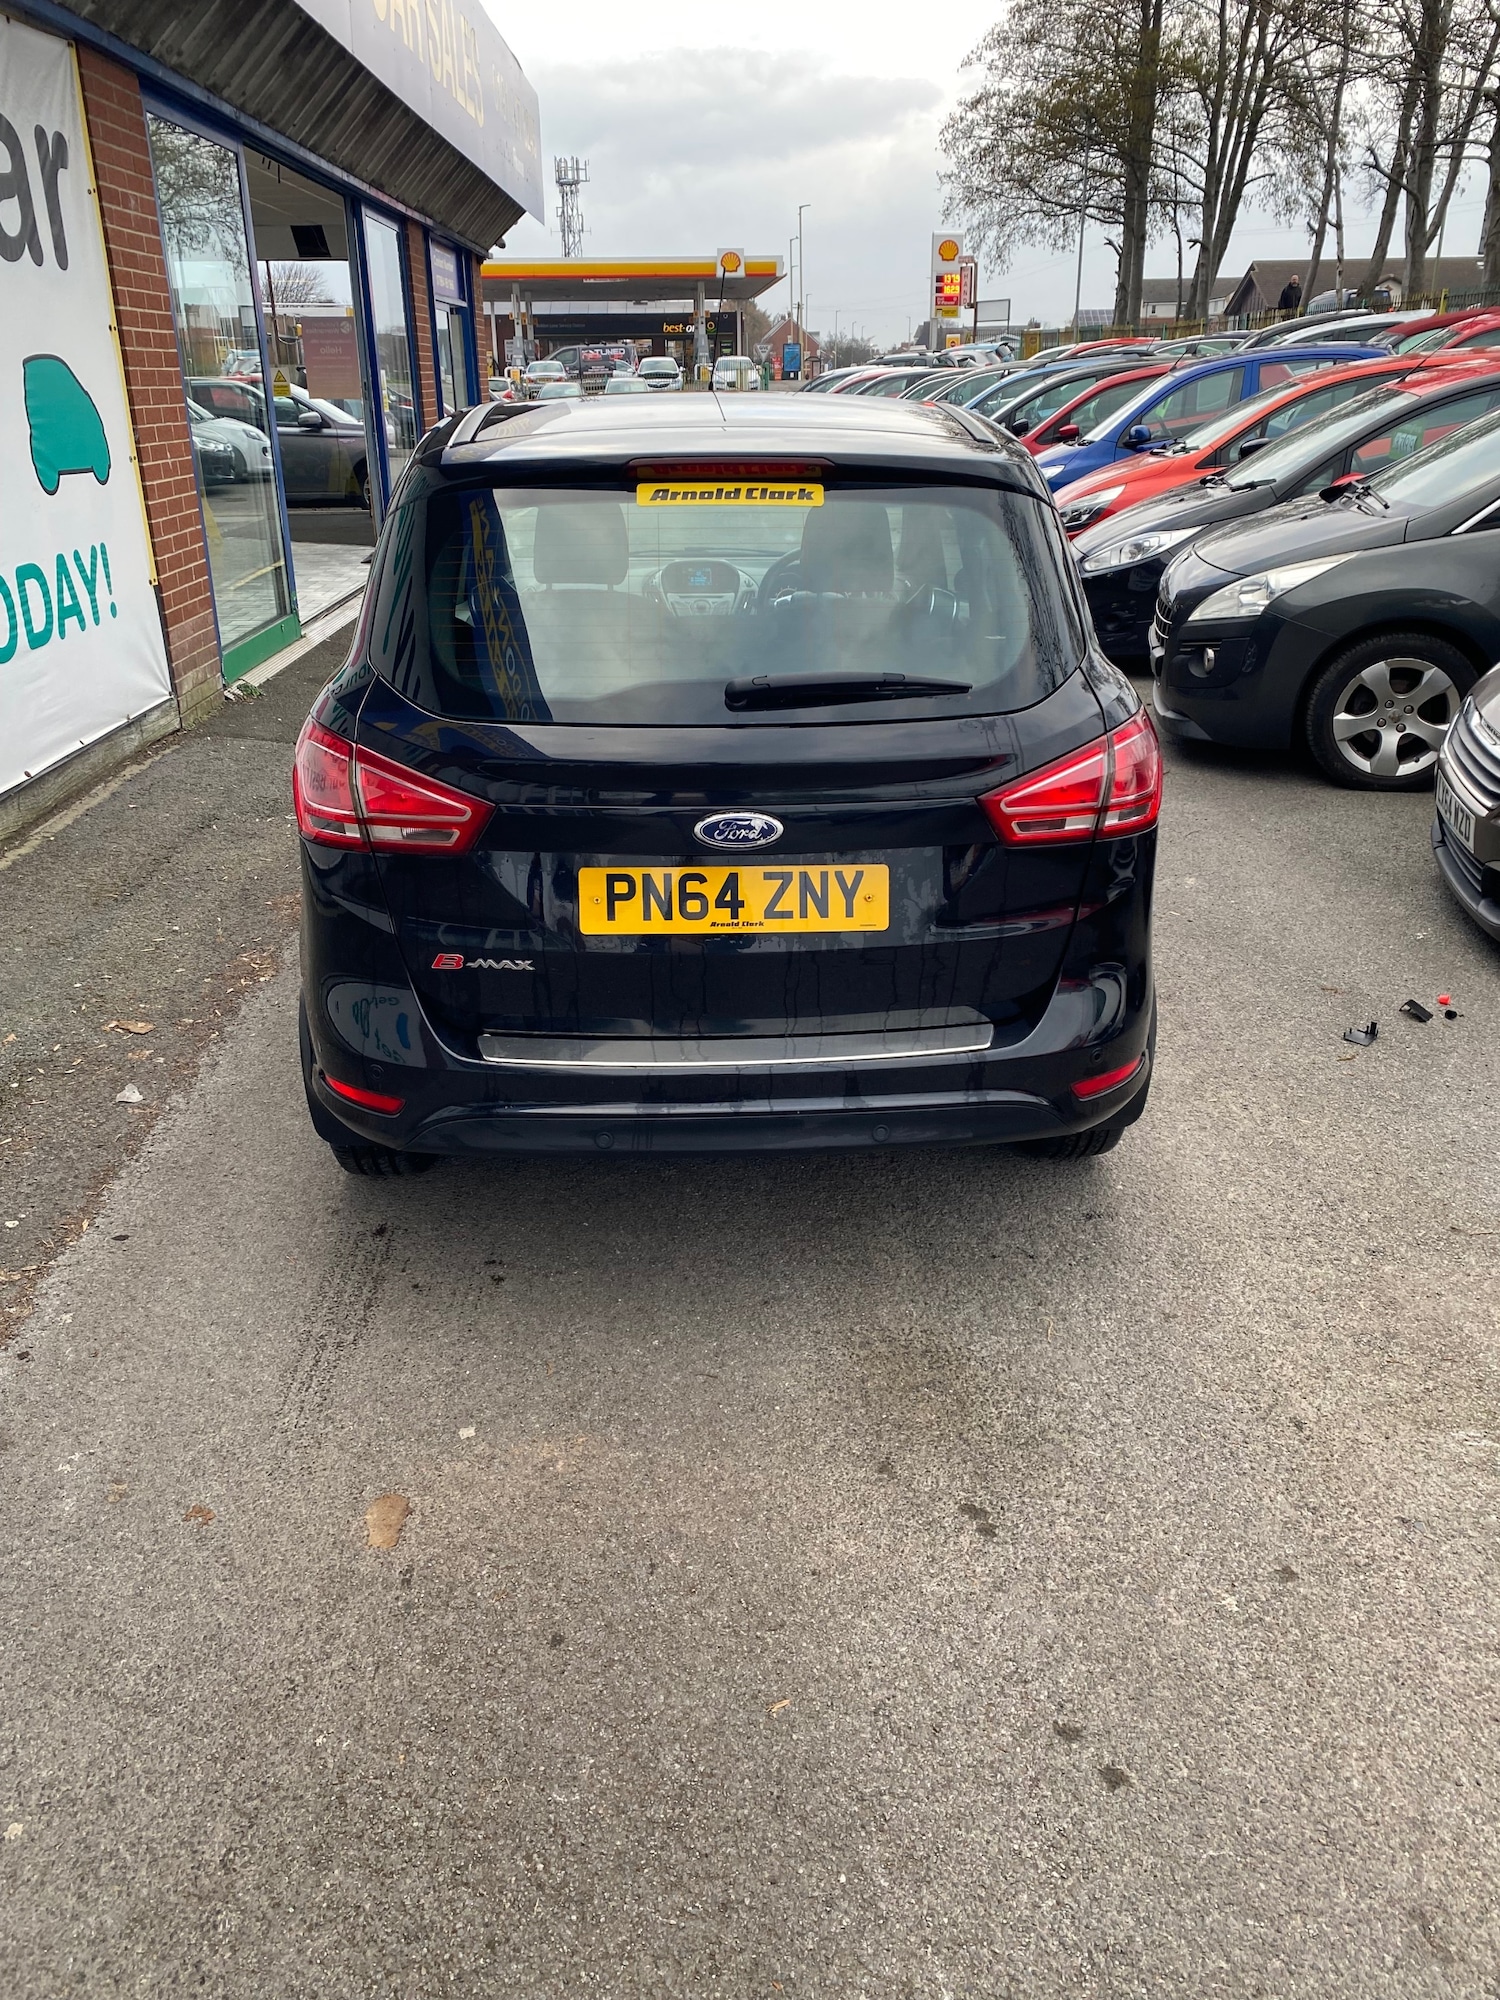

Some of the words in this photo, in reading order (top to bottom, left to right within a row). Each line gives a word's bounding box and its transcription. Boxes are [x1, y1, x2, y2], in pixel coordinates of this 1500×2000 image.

[373, 0, 424, 63] AR
[426, 0, 484, 128] SALES
[650, 488, 741, 501] Arnold
[745, 488, 814, 501] Clark
[713, 818, 768, 841] Ford
[605, 872, 746, 921] PN64
[763, 870, 864, 920] ZNY
[431, 953, 536, 971] B-MAX
